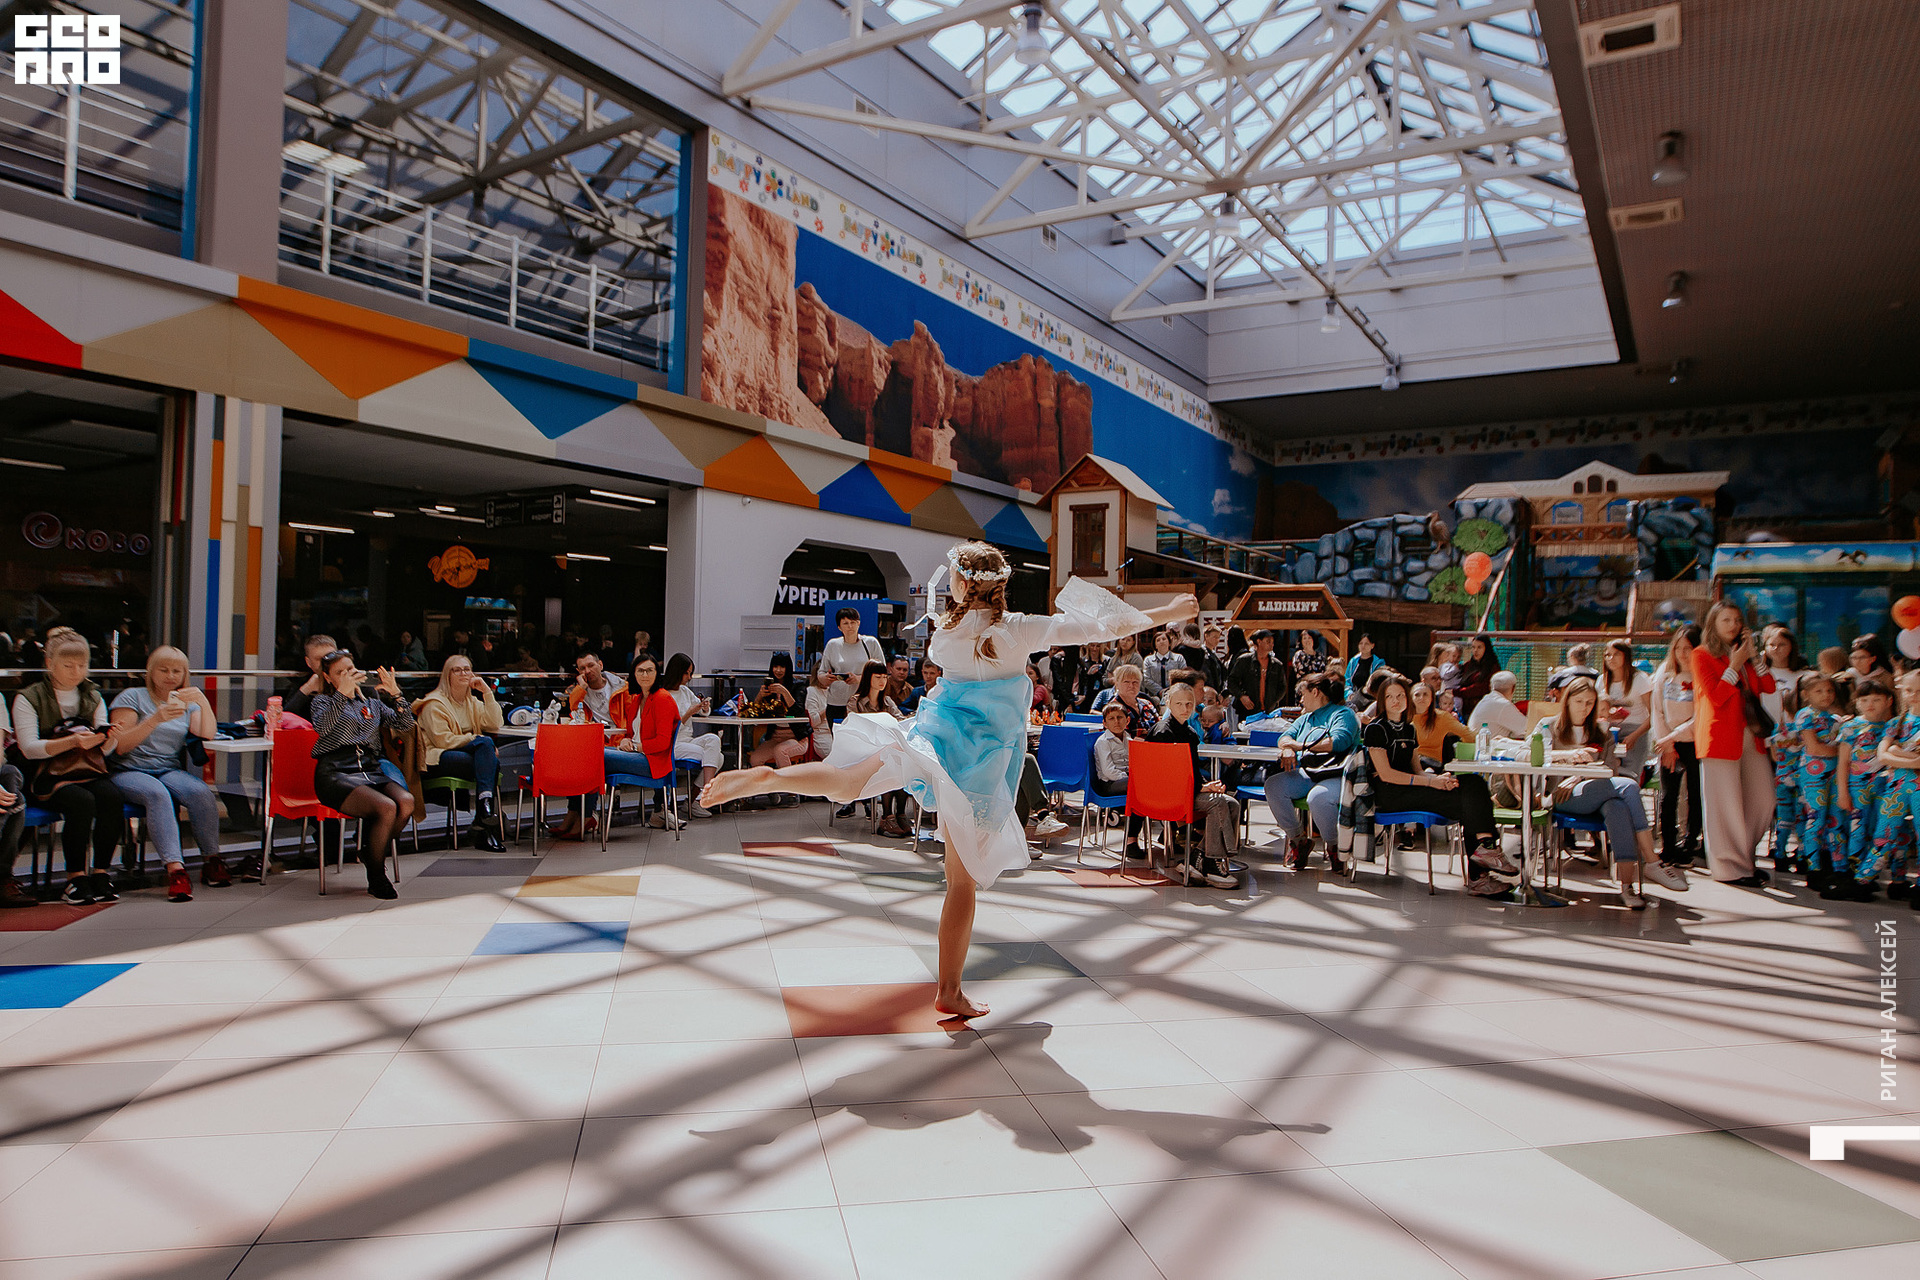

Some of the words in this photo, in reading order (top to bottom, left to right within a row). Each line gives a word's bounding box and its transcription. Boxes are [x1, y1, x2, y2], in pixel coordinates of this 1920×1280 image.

[716, 147, 762, 185] HAPPY
[786, 185, 819, 213] LAND
[843, 214, 878, 246] HAPPY
[897, 245, 923, 268] LAND
[777, 584, 830, 607] УРГЕР
